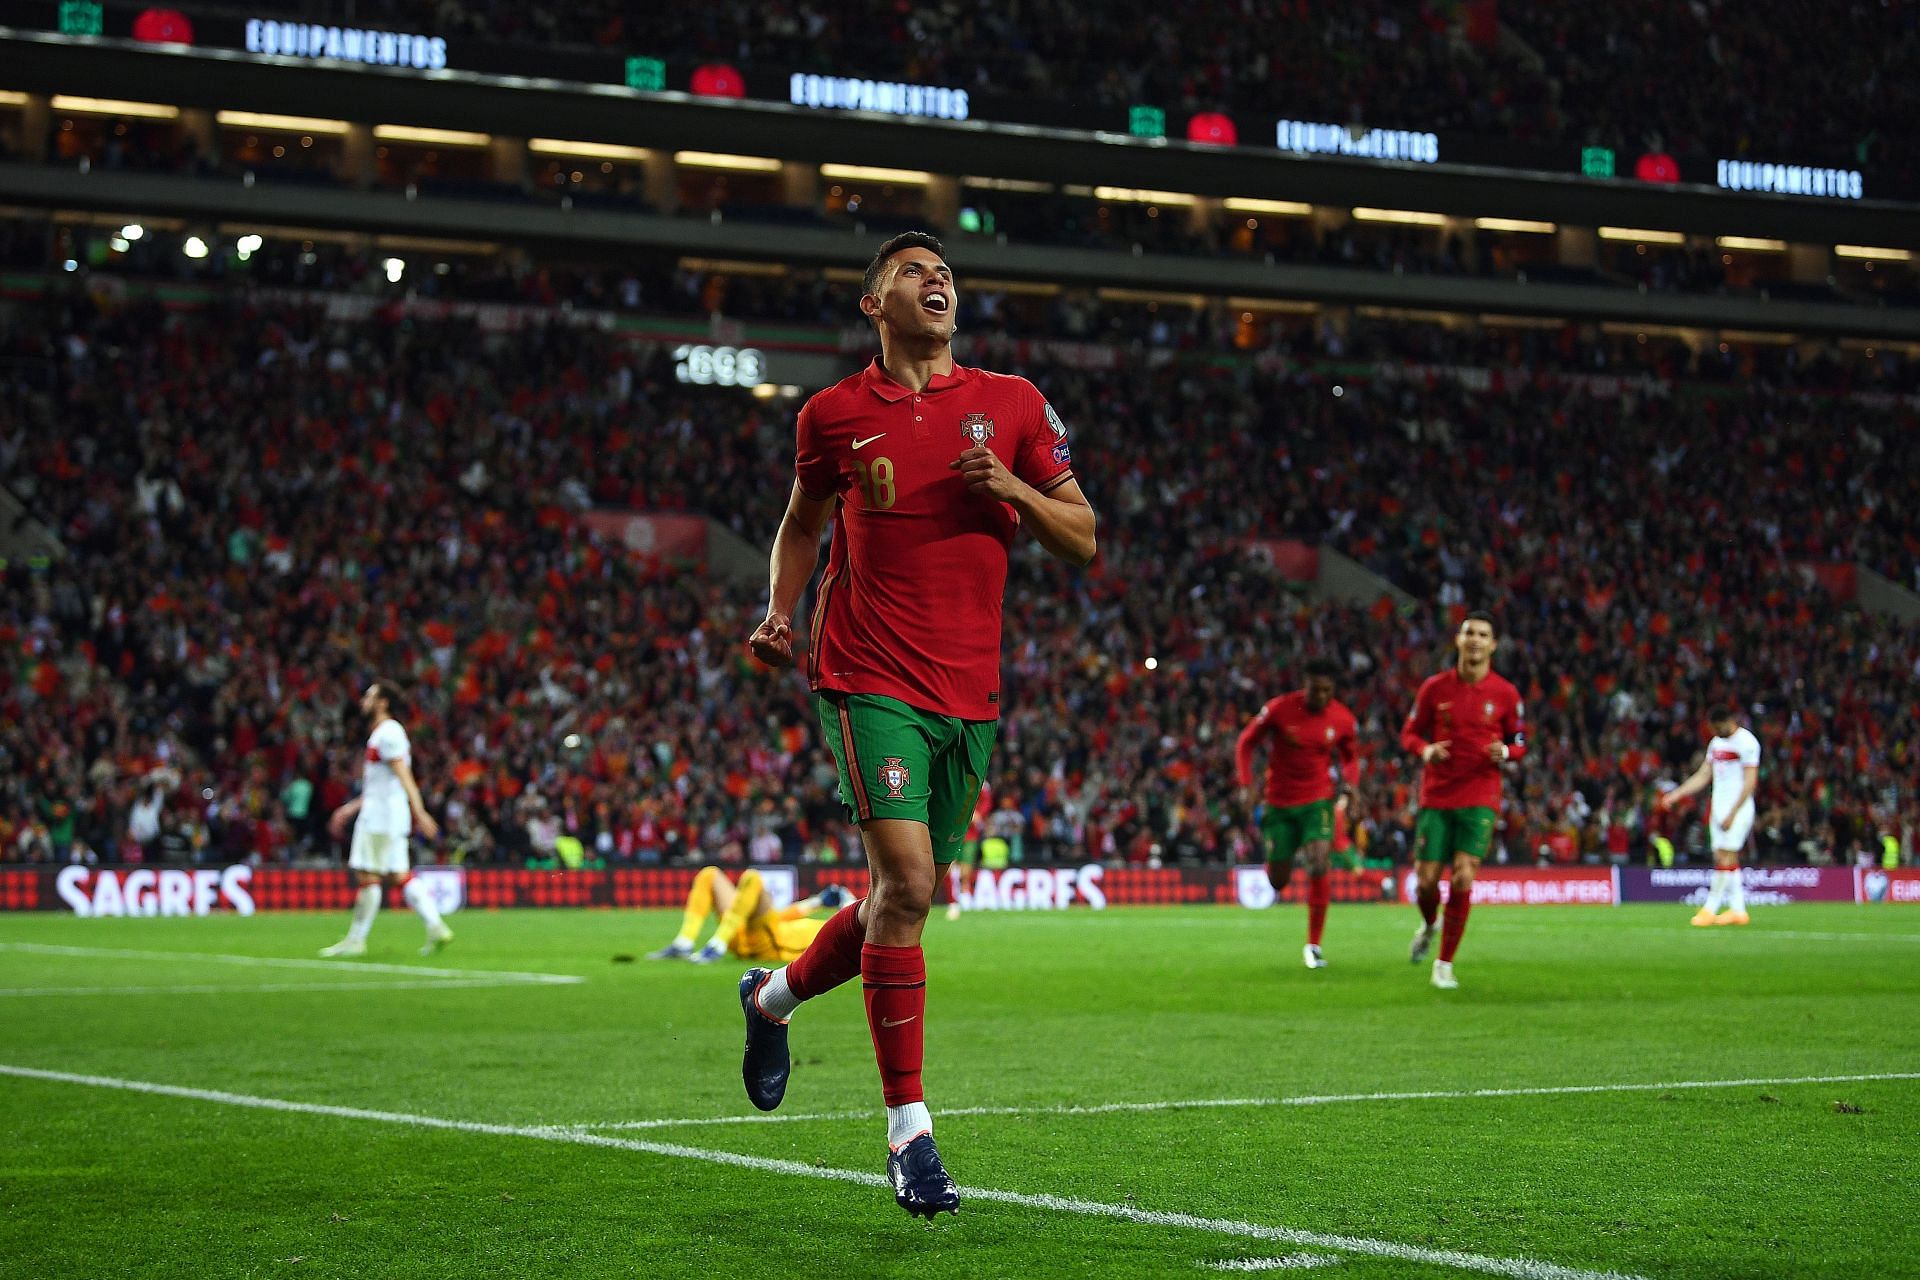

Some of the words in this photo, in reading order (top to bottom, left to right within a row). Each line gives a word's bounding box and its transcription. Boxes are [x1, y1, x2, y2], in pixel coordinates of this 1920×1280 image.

[246, 18, 447, 70] EQUIPAMENTOS
[790, 73, 969, 121] EQUIPAMENTOS
[1717, 158, 1863, 200] EQUIPAMENTOS
[55, 864, 255, 918] SAGRES
